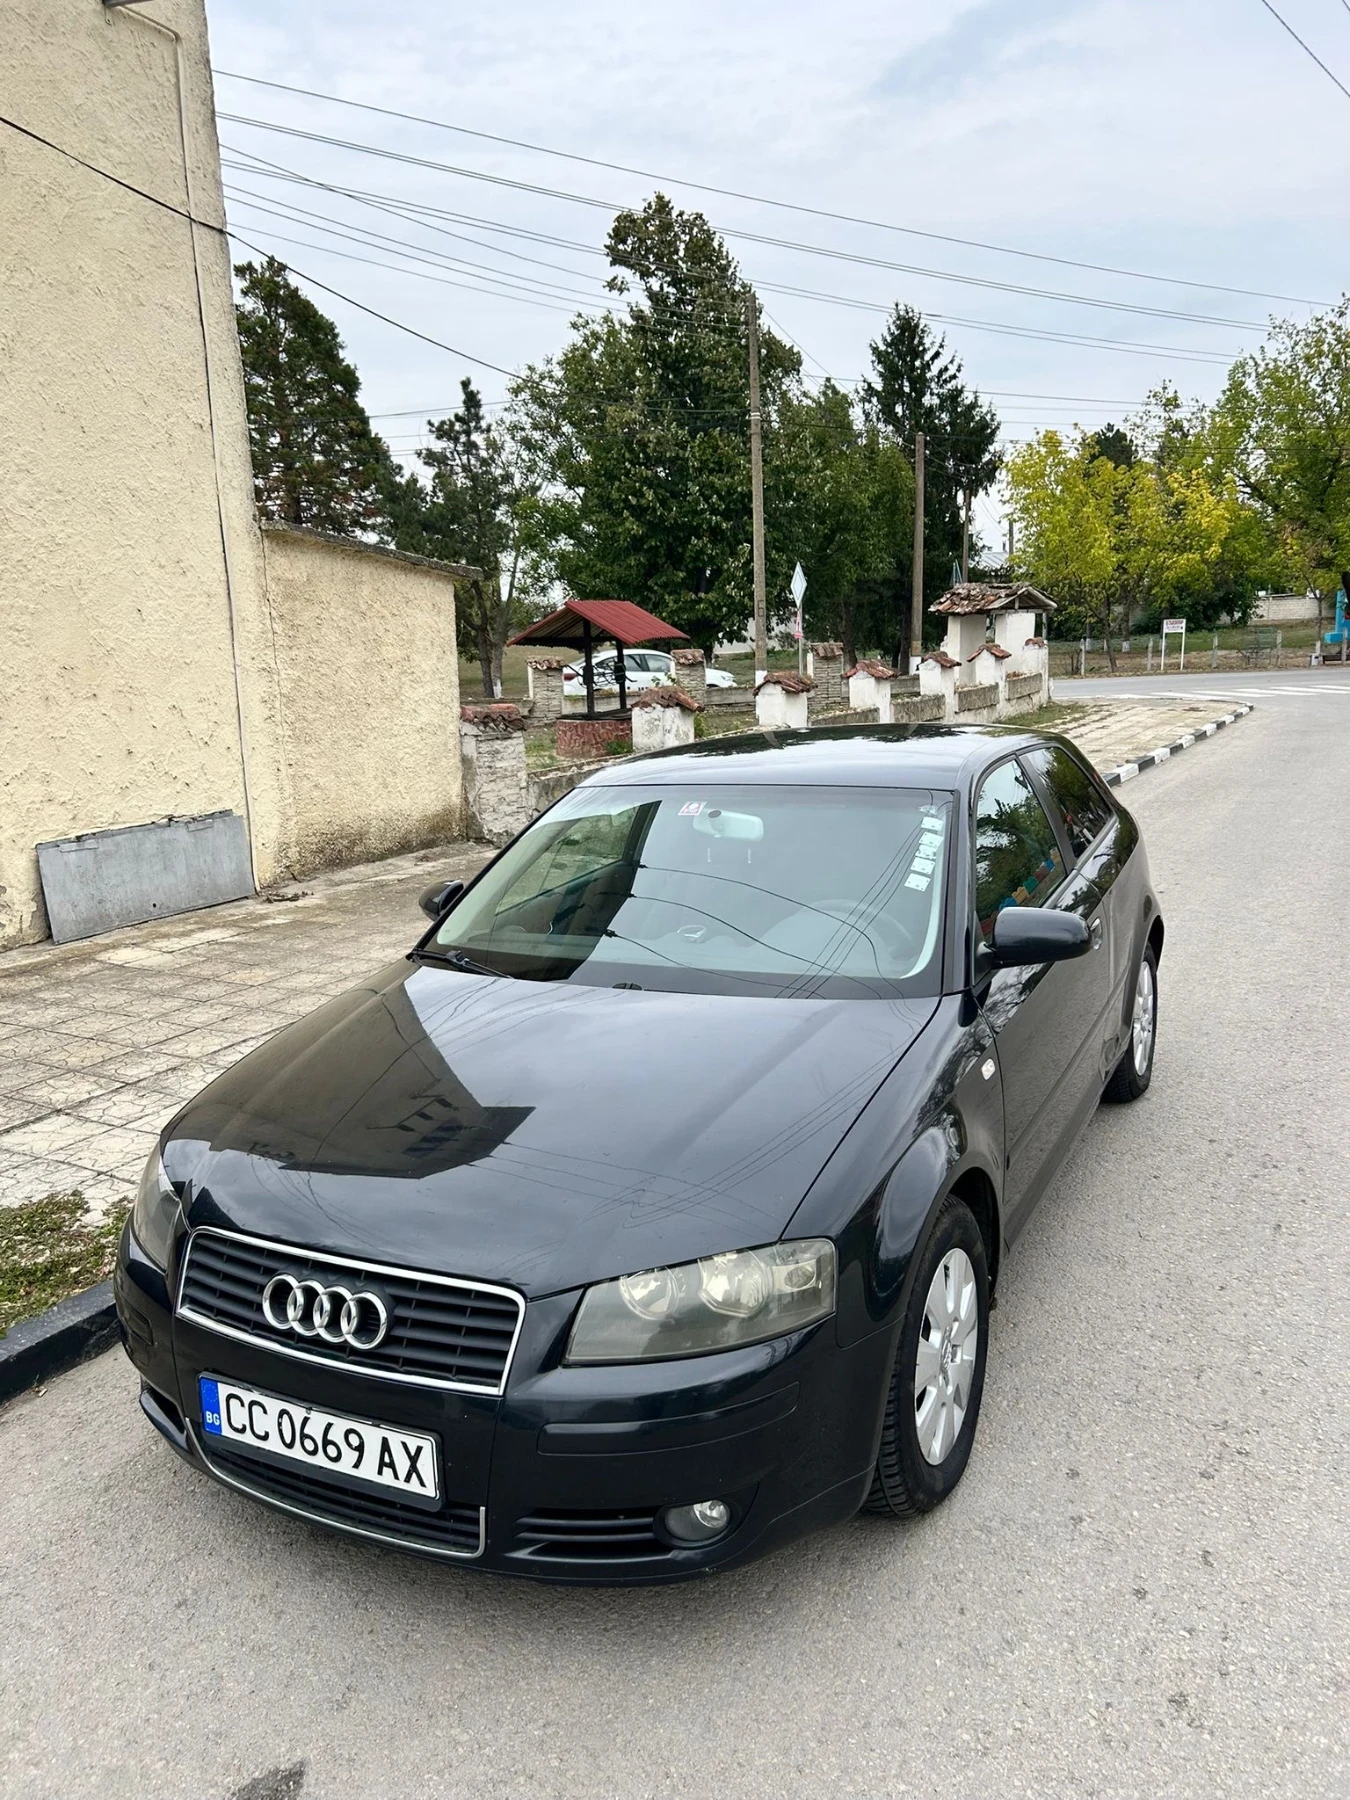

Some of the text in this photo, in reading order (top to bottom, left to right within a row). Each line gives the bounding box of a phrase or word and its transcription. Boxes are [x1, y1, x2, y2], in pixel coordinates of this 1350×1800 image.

[206, 1411, 220, 1425] BG
[225, 1393, 428, 1489] CC 0669 AX
